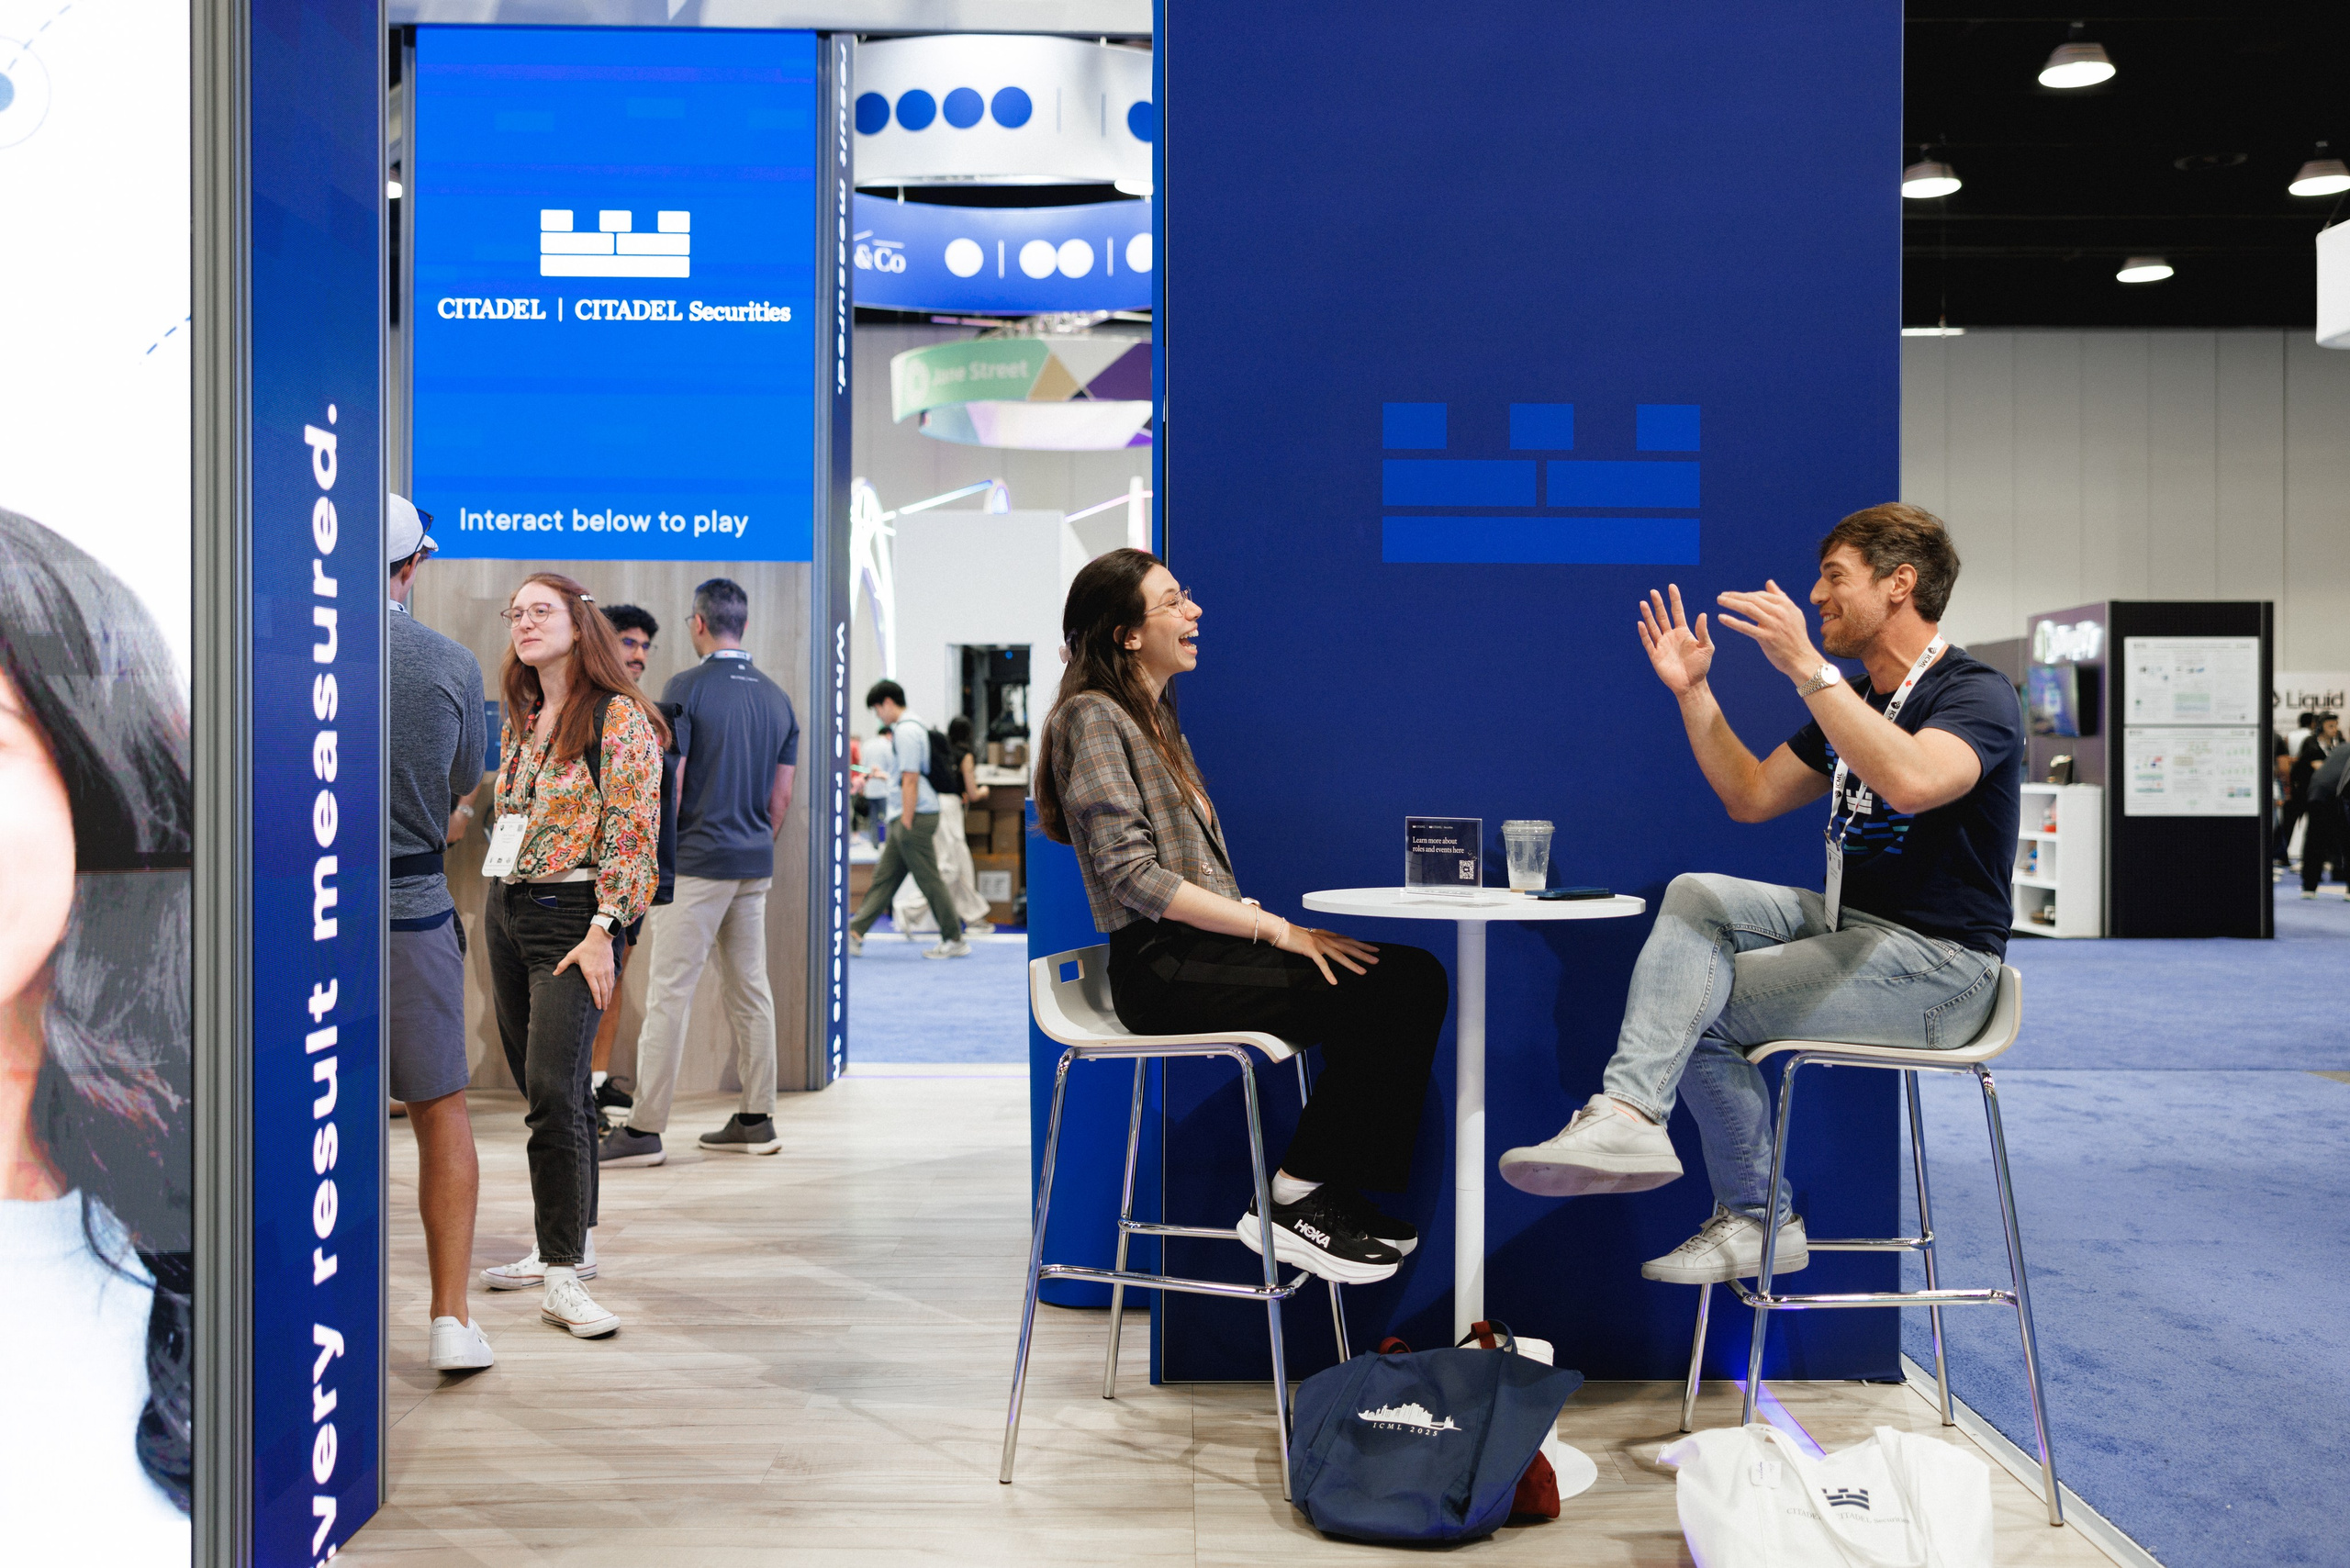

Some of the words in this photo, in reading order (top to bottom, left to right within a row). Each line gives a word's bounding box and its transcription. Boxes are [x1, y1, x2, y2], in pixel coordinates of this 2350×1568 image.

[437, 297, 547, 320] CITADEL
[574, 298, 684, 321] CITADEL
[688, 300, 792, 322] Securities
[460, 507, 564, 532] Interact
[573, 508, 652, 532] below
[658, 510, 687, 532] to
[693, 509, 749, 539] play
[304, 403, 339, 942] measured.
[1919, 654, 1932, 668] ICML
[2286, 689, 2344, 713] Liquid
[1412, 845, 1425, 853] roles
[305, 978, 339, 1286] result
[1293, 1218, 1331, 1249] HOKA
[1372, 1422, 1403, 1430] ICML
[1409, 1426, 1438, 1437] 2025
